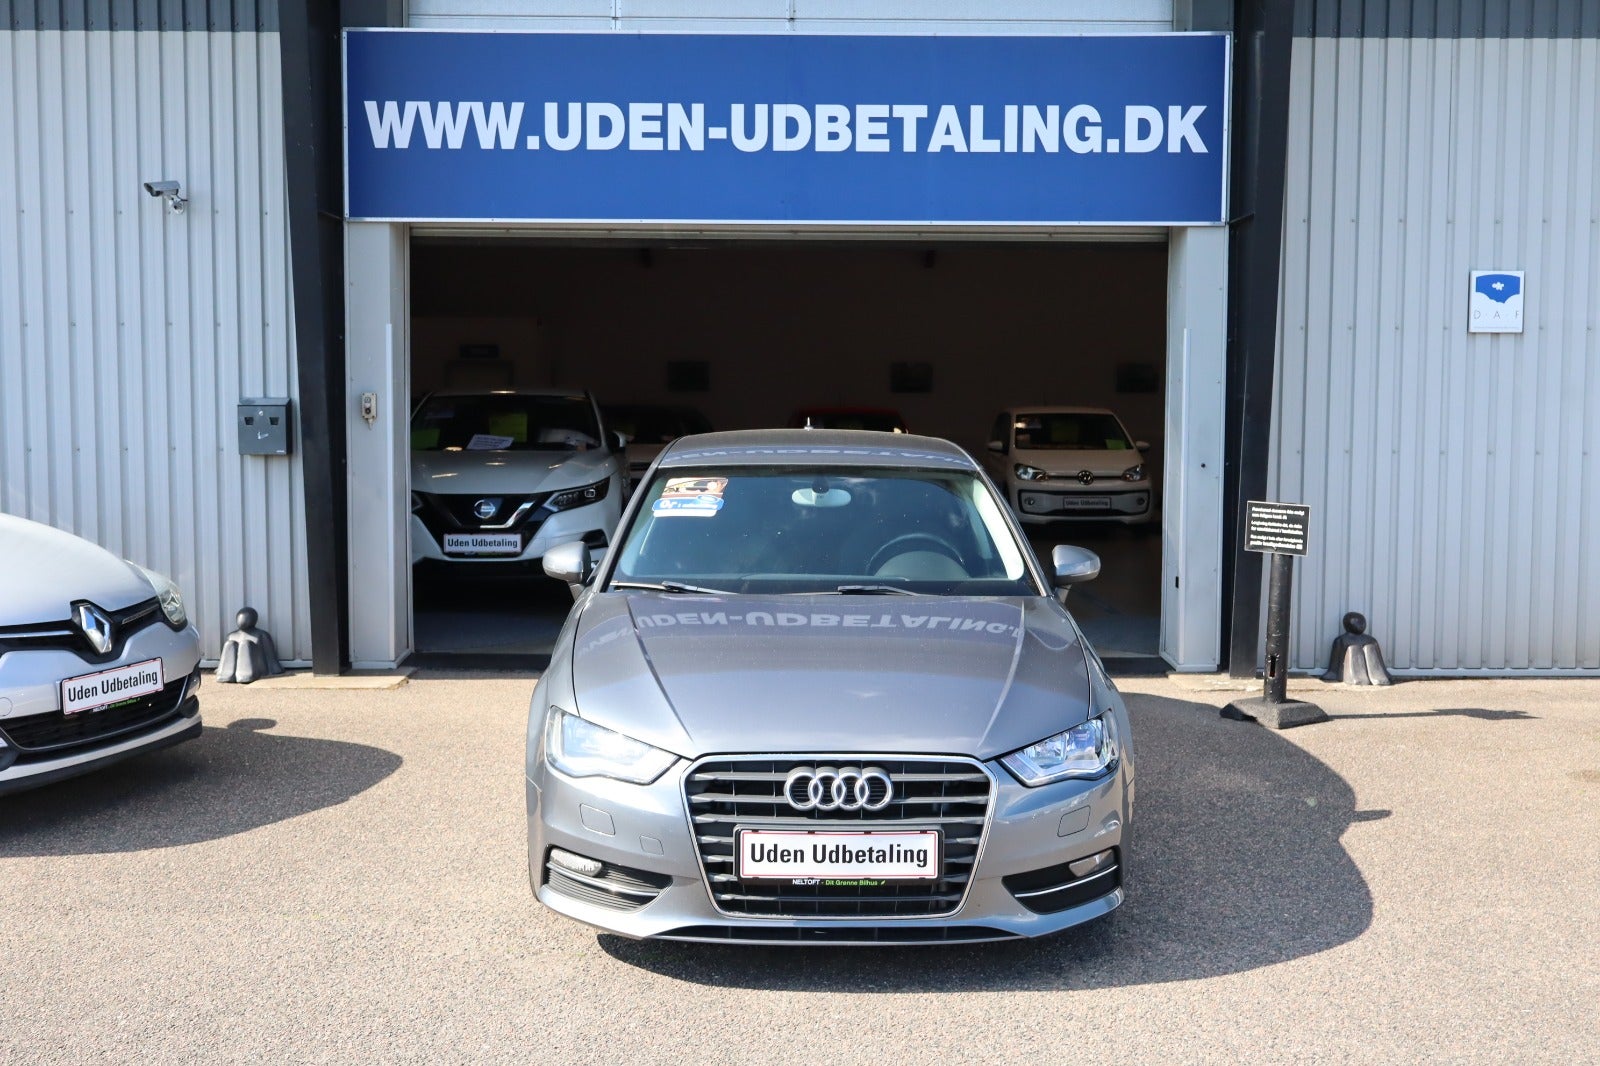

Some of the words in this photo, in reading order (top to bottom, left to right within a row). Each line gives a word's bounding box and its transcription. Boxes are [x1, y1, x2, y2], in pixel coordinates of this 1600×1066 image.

[364, 100, 1209, 154] WWW.UDEN-UDBETALING.DK
[447, 539, 470, 547] Uden
[471, 539, 518, 548] Udbetaling
[68, 685, 98, 702] Uden
[101, 670, 158, 694] Udbetaling
[750, 843, 805, 863] Uden
[812, 843, 928, 868] Udbetaling
